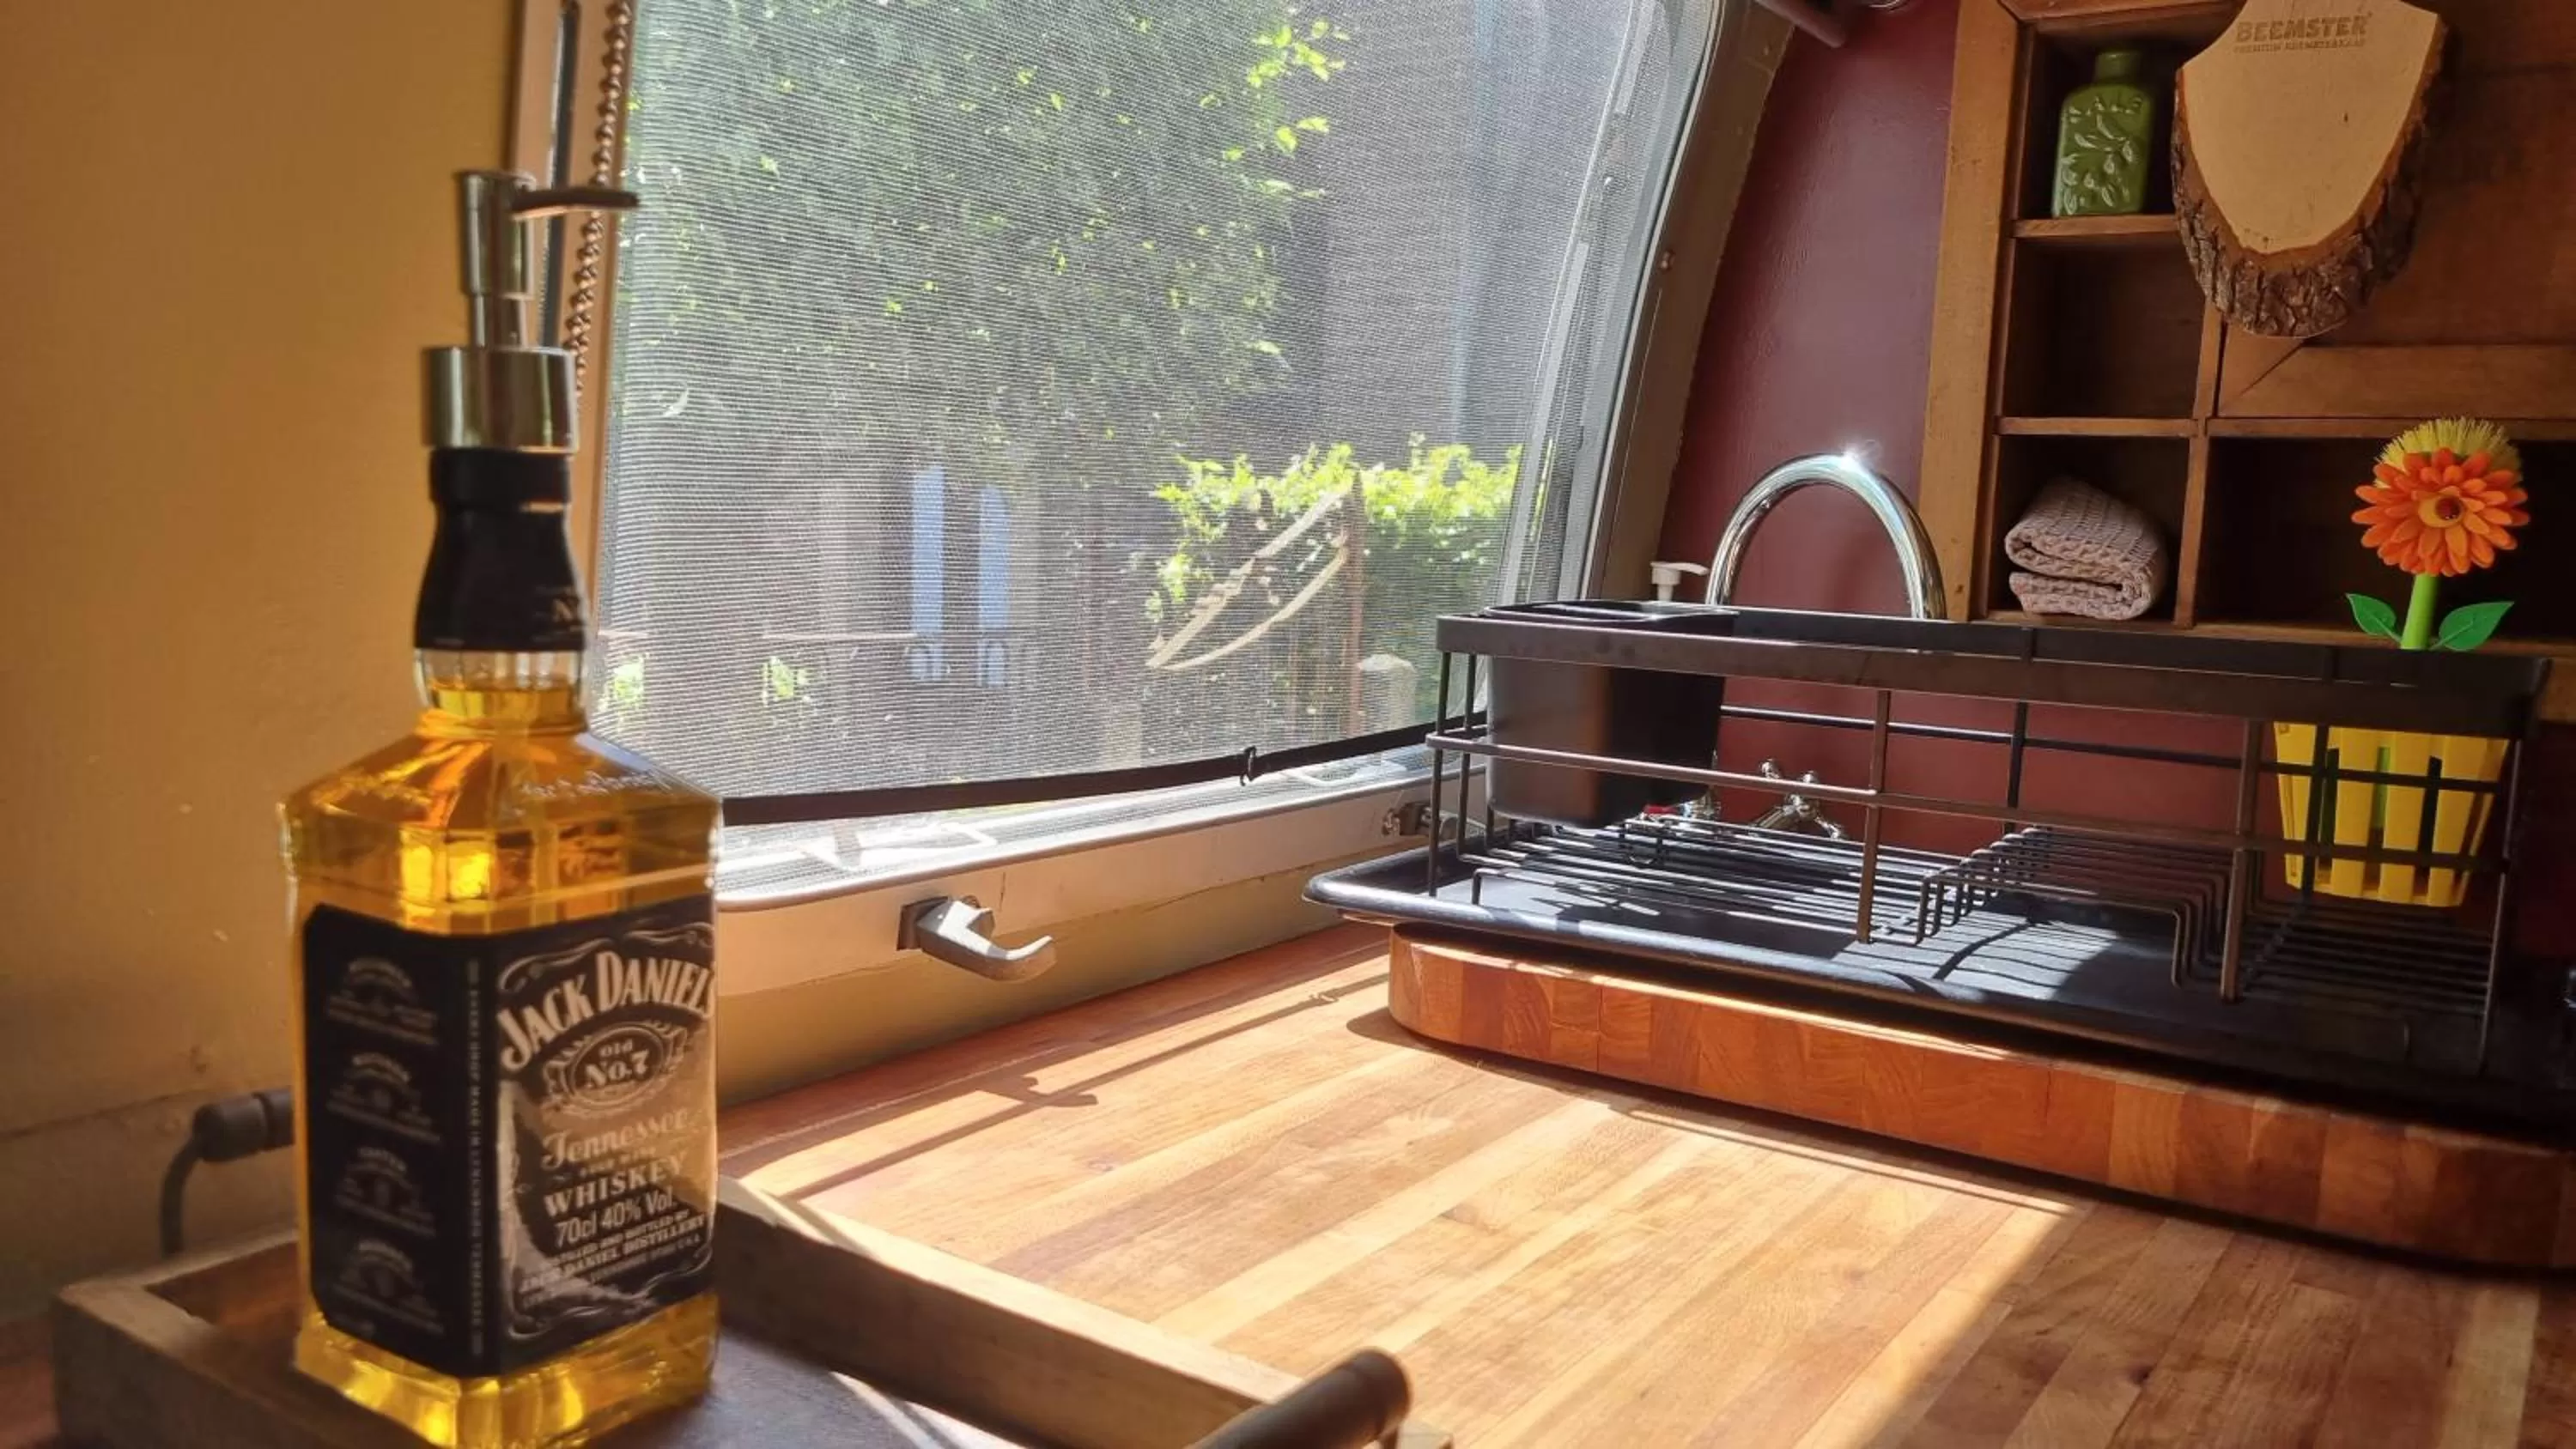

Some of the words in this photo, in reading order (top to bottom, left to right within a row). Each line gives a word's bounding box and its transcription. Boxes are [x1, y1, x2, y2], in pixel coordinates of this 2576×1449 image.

[2236, 15, 2367, 42] BEEMSTER
[496, 974, 594, 1070] JACK
[544, 1154, 685, 1217] WHISKEY
[556, 1210, 598, 1249] 70cl
[601, 1197, 642, 1230] 40%
